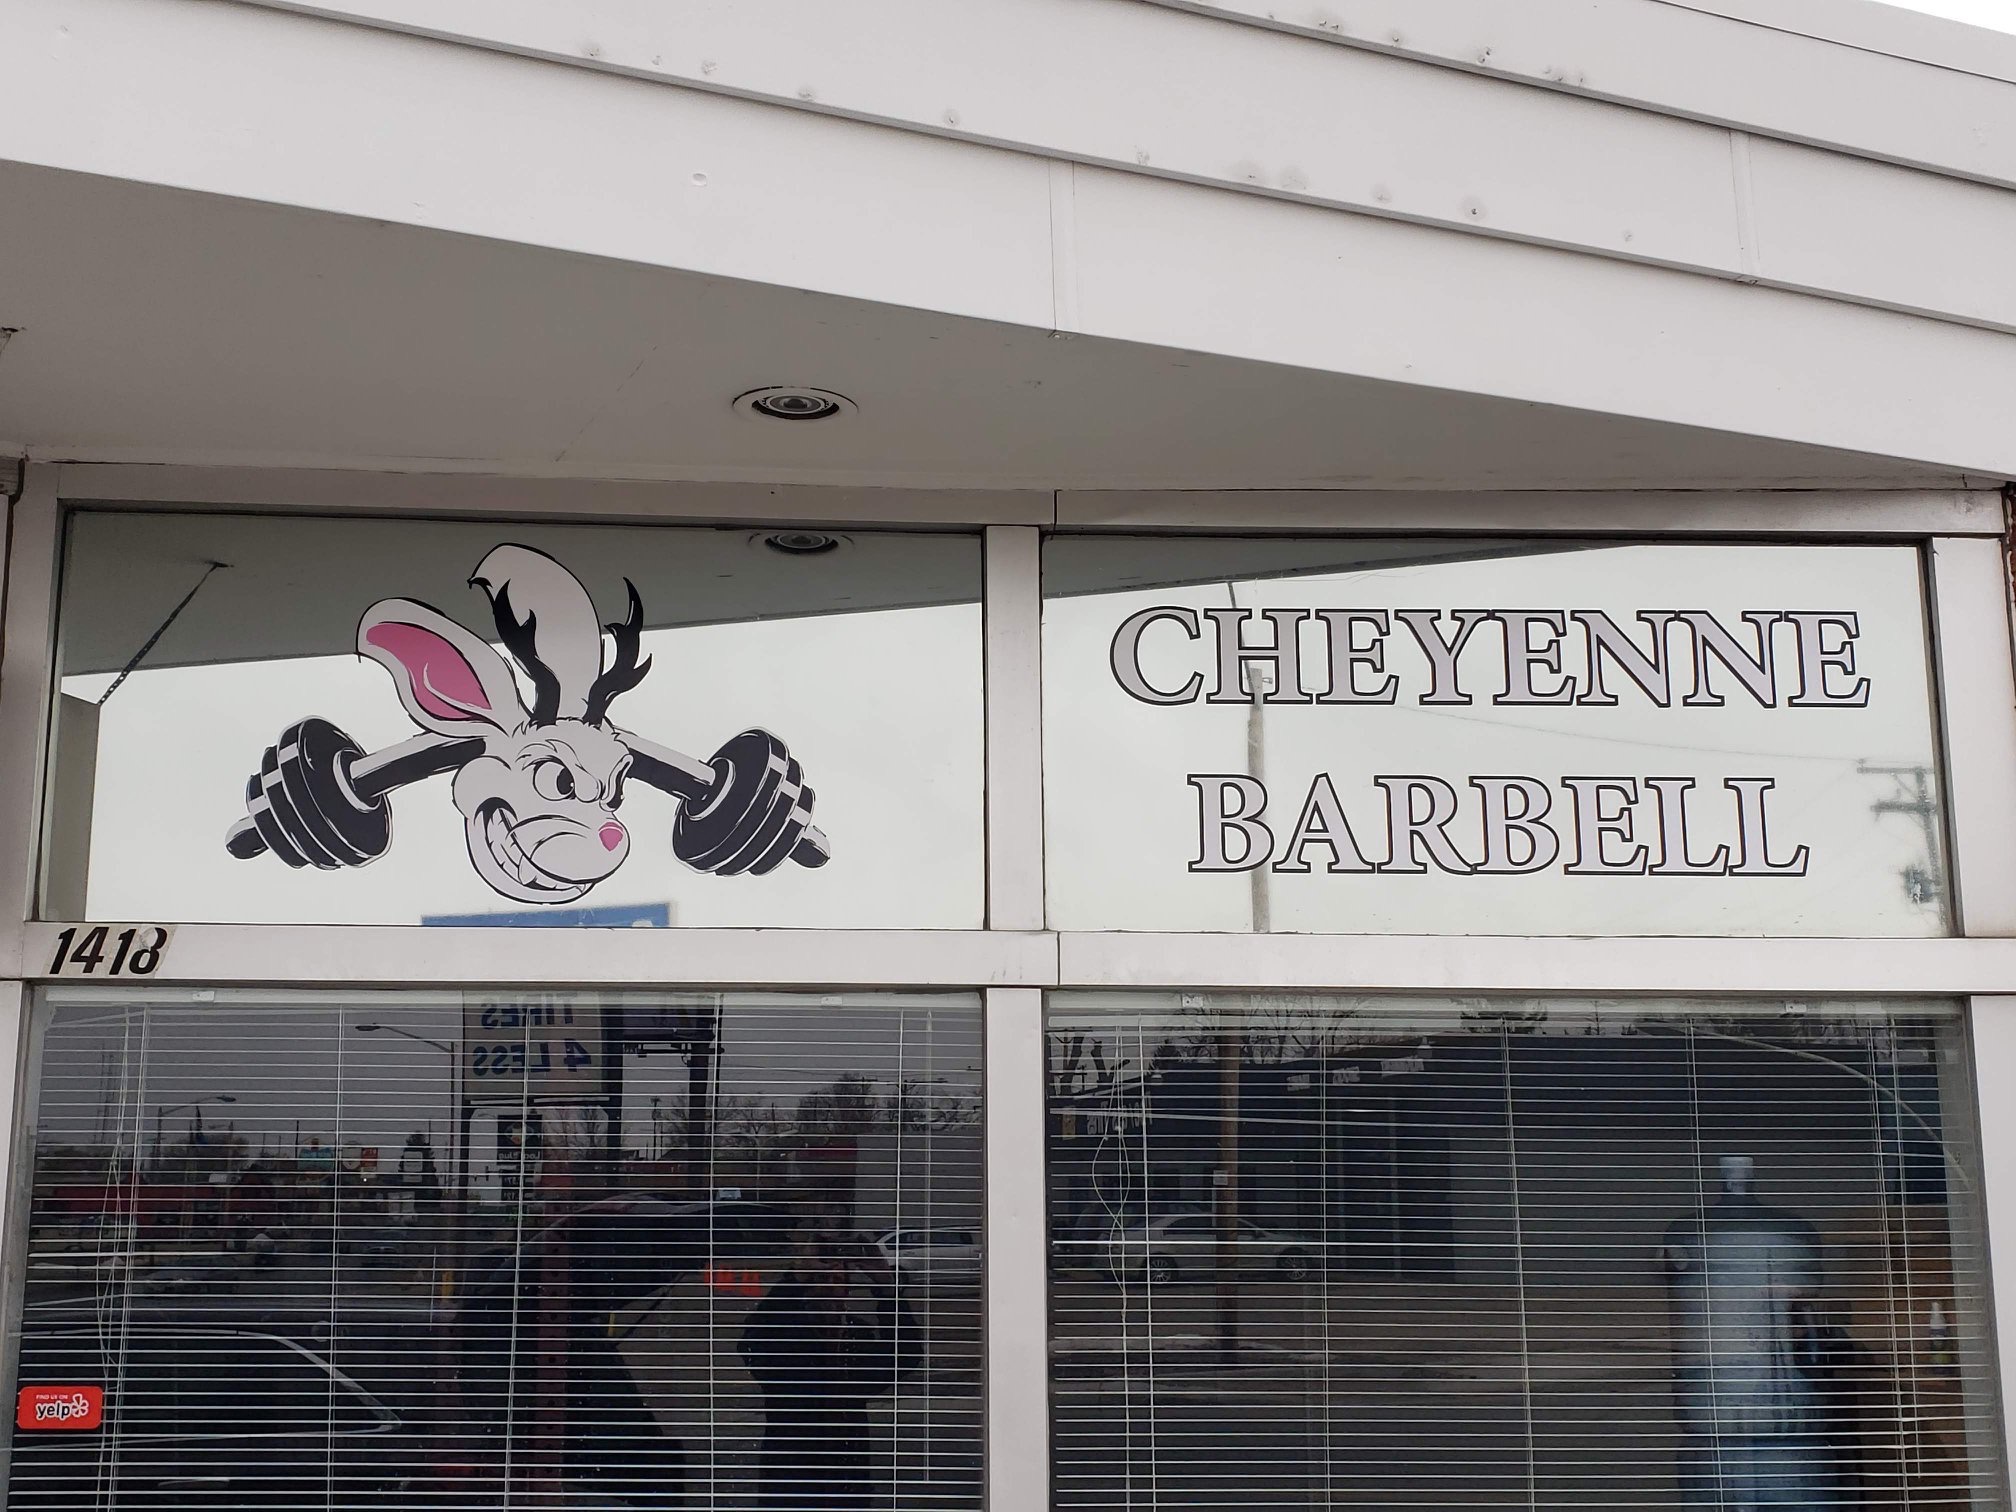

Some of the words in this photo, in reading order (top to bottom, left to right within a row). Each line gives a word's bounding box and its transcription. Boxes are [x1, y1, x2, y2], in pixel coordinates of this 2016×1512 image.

[1109, 605, 1871, 708] CHEYENNE
[1186, 772, 1810, 877] BARBELL
[49, 926, 168, 975] 1418
[36, 1401, 71, 1420] yelp
